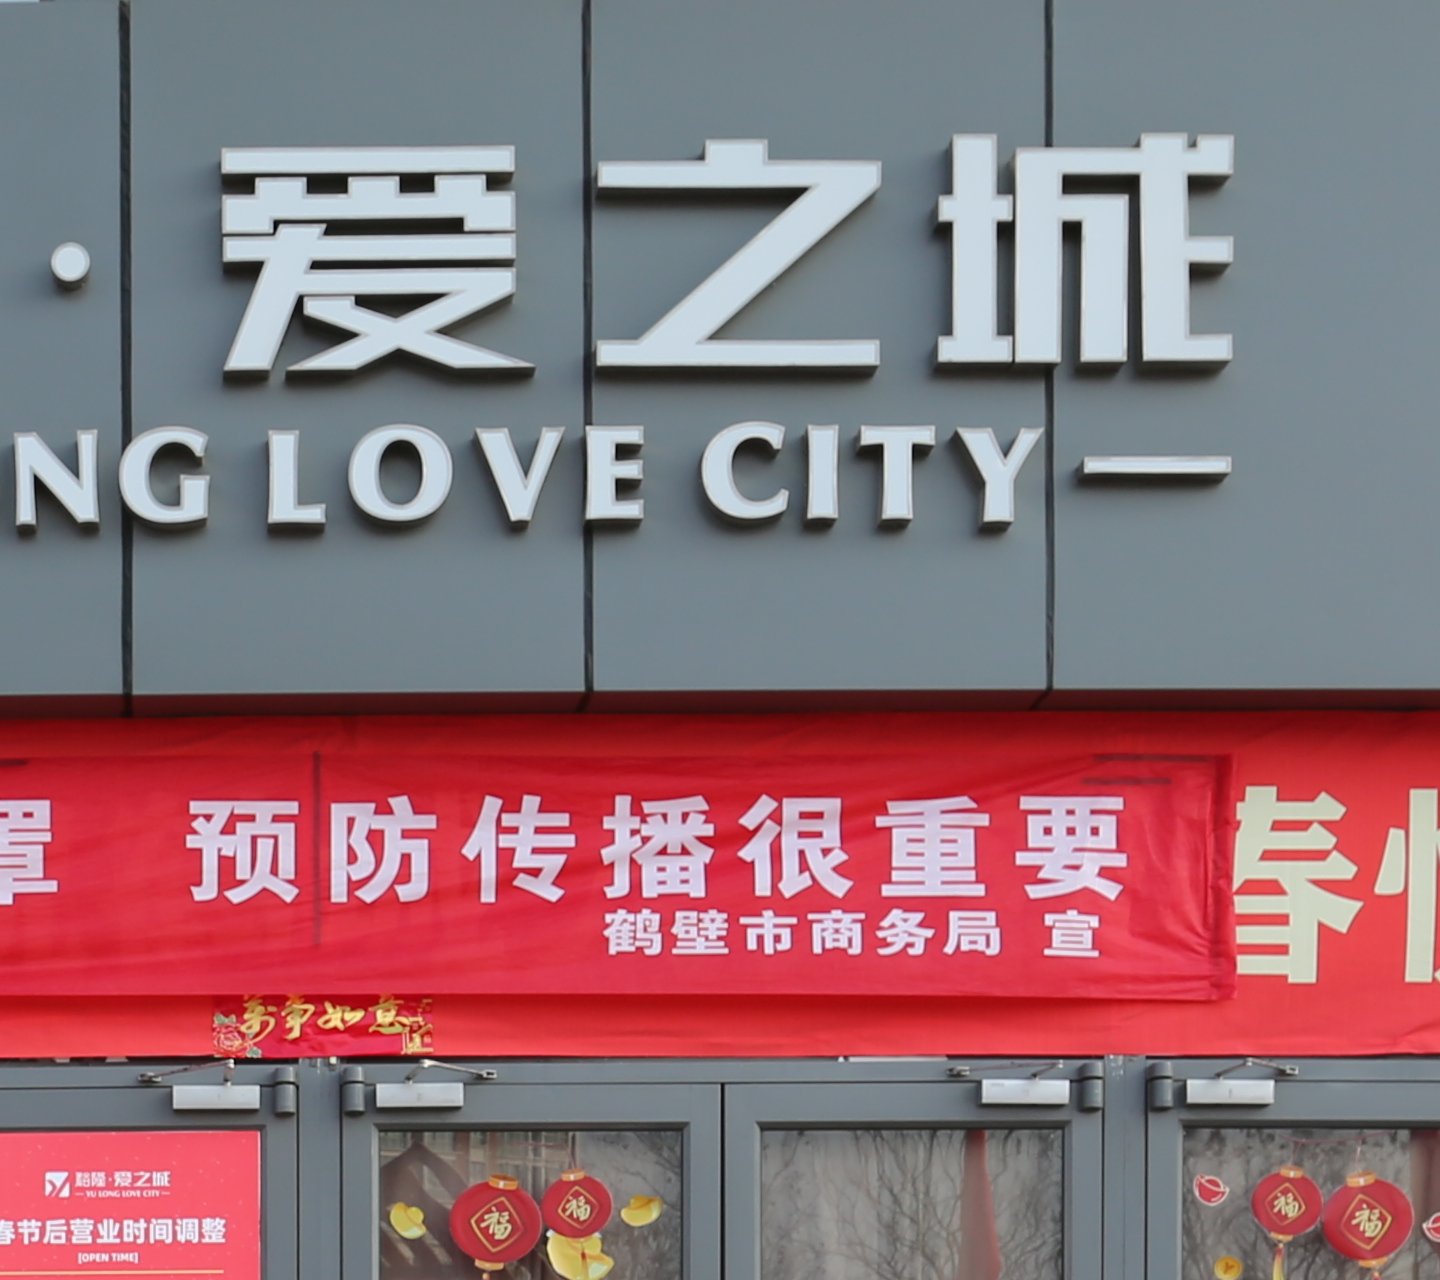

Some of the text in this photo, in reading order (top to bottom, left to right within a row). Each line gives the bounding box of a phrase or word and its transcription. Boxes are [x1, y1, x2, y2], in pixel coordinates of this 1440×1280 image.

[267, 422, 648, 530] LOVE
[701, 419, 1045, 530] CITY
[183, 794, 1130, 905] 预防传播很重要
[603, 908, 1102, 958] 鹤壁市商务局 宣
